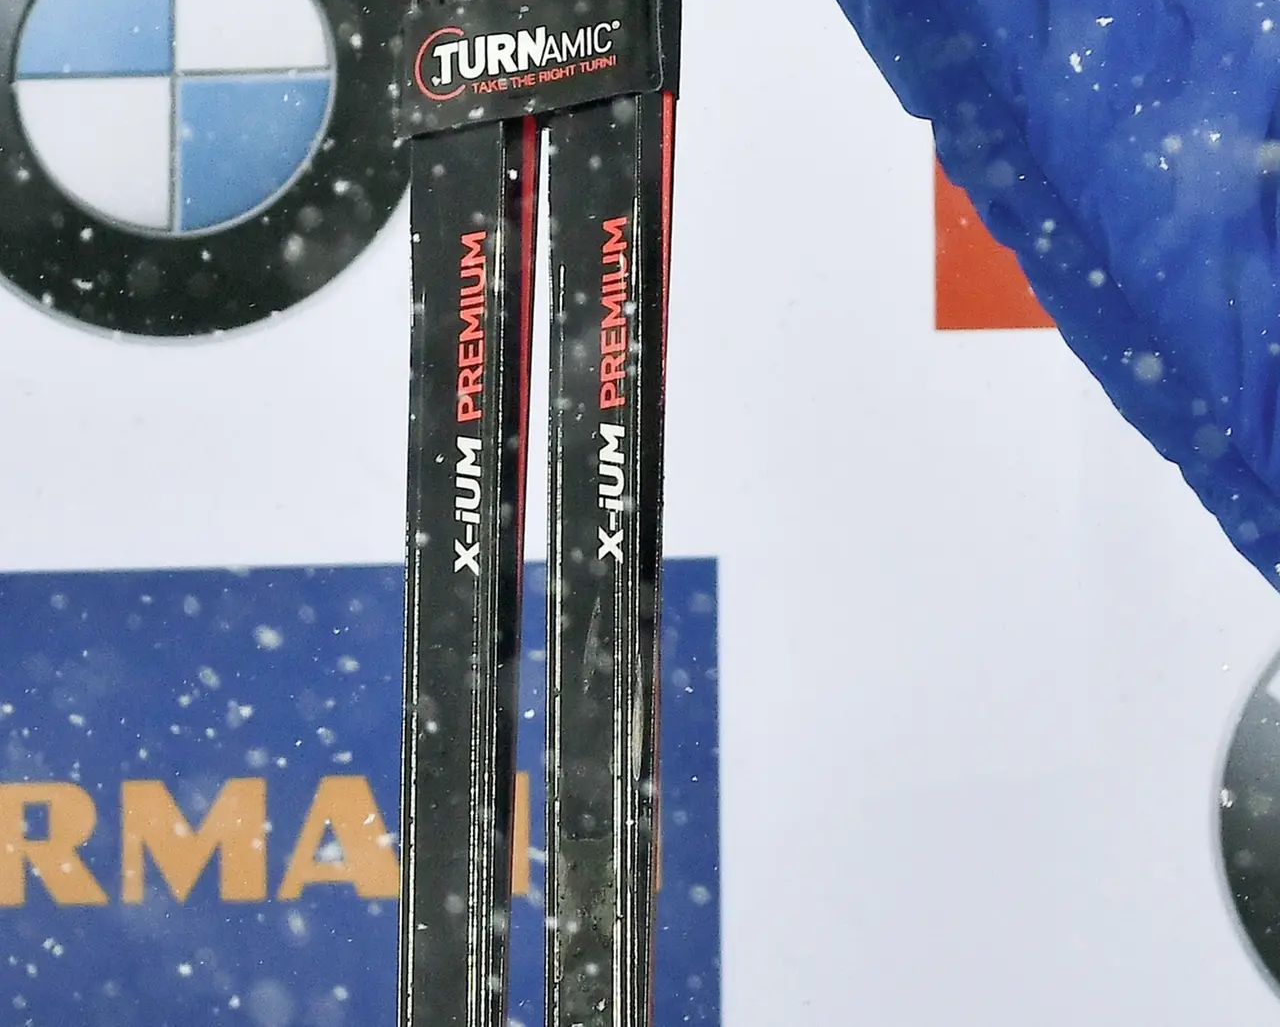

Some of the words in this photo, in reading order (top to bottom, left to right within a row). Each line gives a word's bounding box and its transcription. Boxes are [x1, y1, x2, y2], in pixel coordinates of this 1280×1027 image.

[471, 78, 508, 95] TAKE
[510, 73, 536, 89] THE
[539, 64, 577, 82] RIGHT
[456, 230, 487, 423] PREMIUM
[598, 216, 629, 408] PREMIUM
